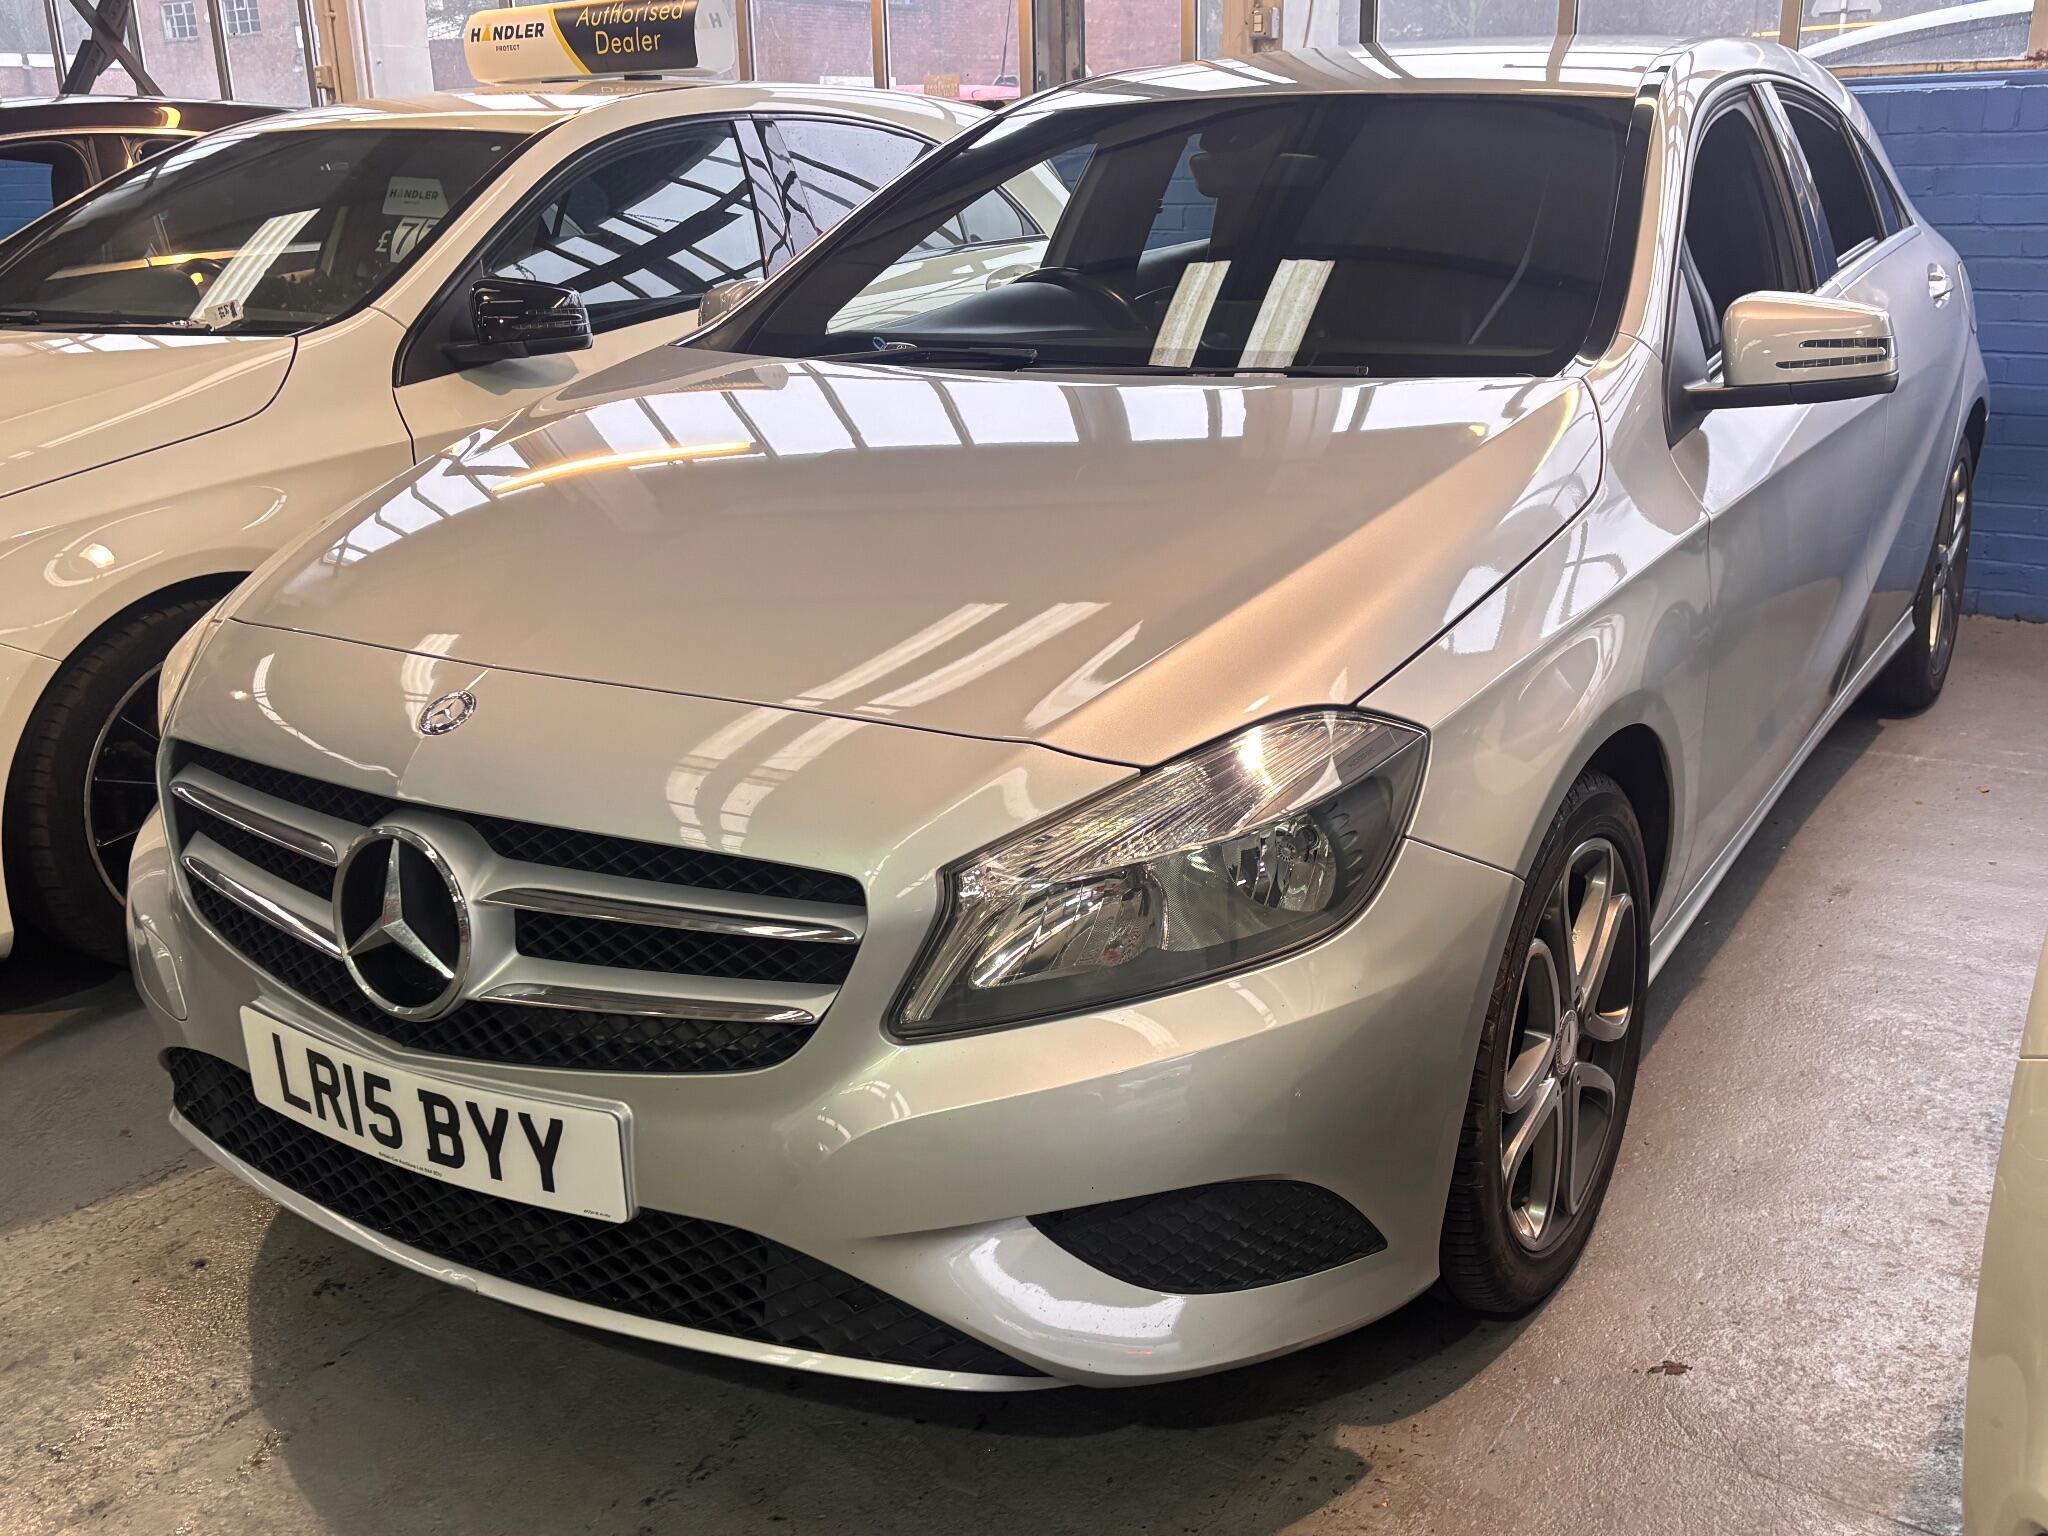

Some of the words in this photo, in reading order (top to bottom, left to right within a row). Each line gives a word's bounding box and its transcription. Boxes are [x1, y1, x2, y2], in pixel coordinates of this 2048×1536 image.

[575, 0, 685, 27] Authorised
[495, 44, 520, 52] PROTECT
[595, 26, 661, 55] Dealer
[272, 1033, 403, 1150] LR15
[418, 1089, 564, 1193] BYY
